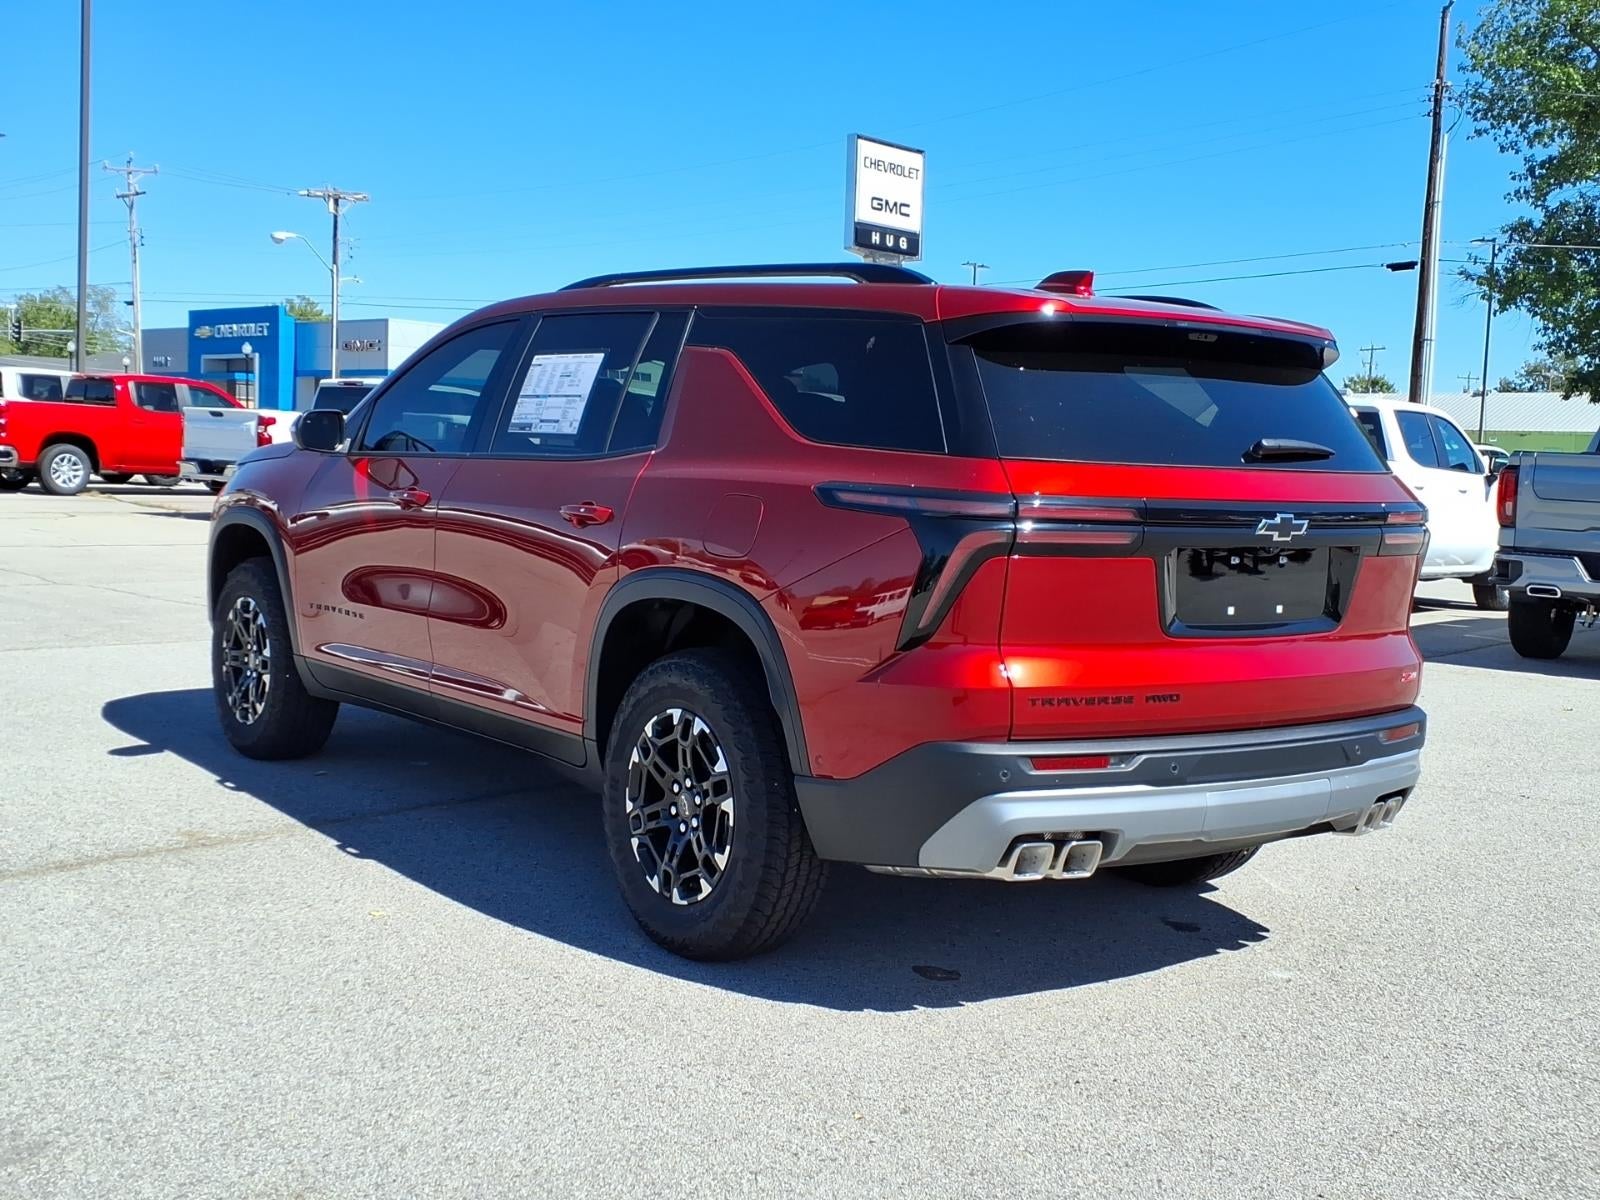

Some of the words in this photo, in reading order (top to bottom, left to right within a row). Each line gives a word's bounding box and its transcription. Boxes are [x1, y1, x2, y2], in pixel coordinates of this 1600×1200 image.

[864, 156, 920, 180] CHEVROLET
[870, 196, 911, 217] GMC
[871, 231, 908, 249] HUG
[214, 322, 270, 338] CHEVROLET
[342, 339, 381, 352] GMC
[309, 602, 365, 619] TRAVERSE
[1028, 695, 1134, 707] TRAVERSE
[1145, 693, 1180, 704] AWD
